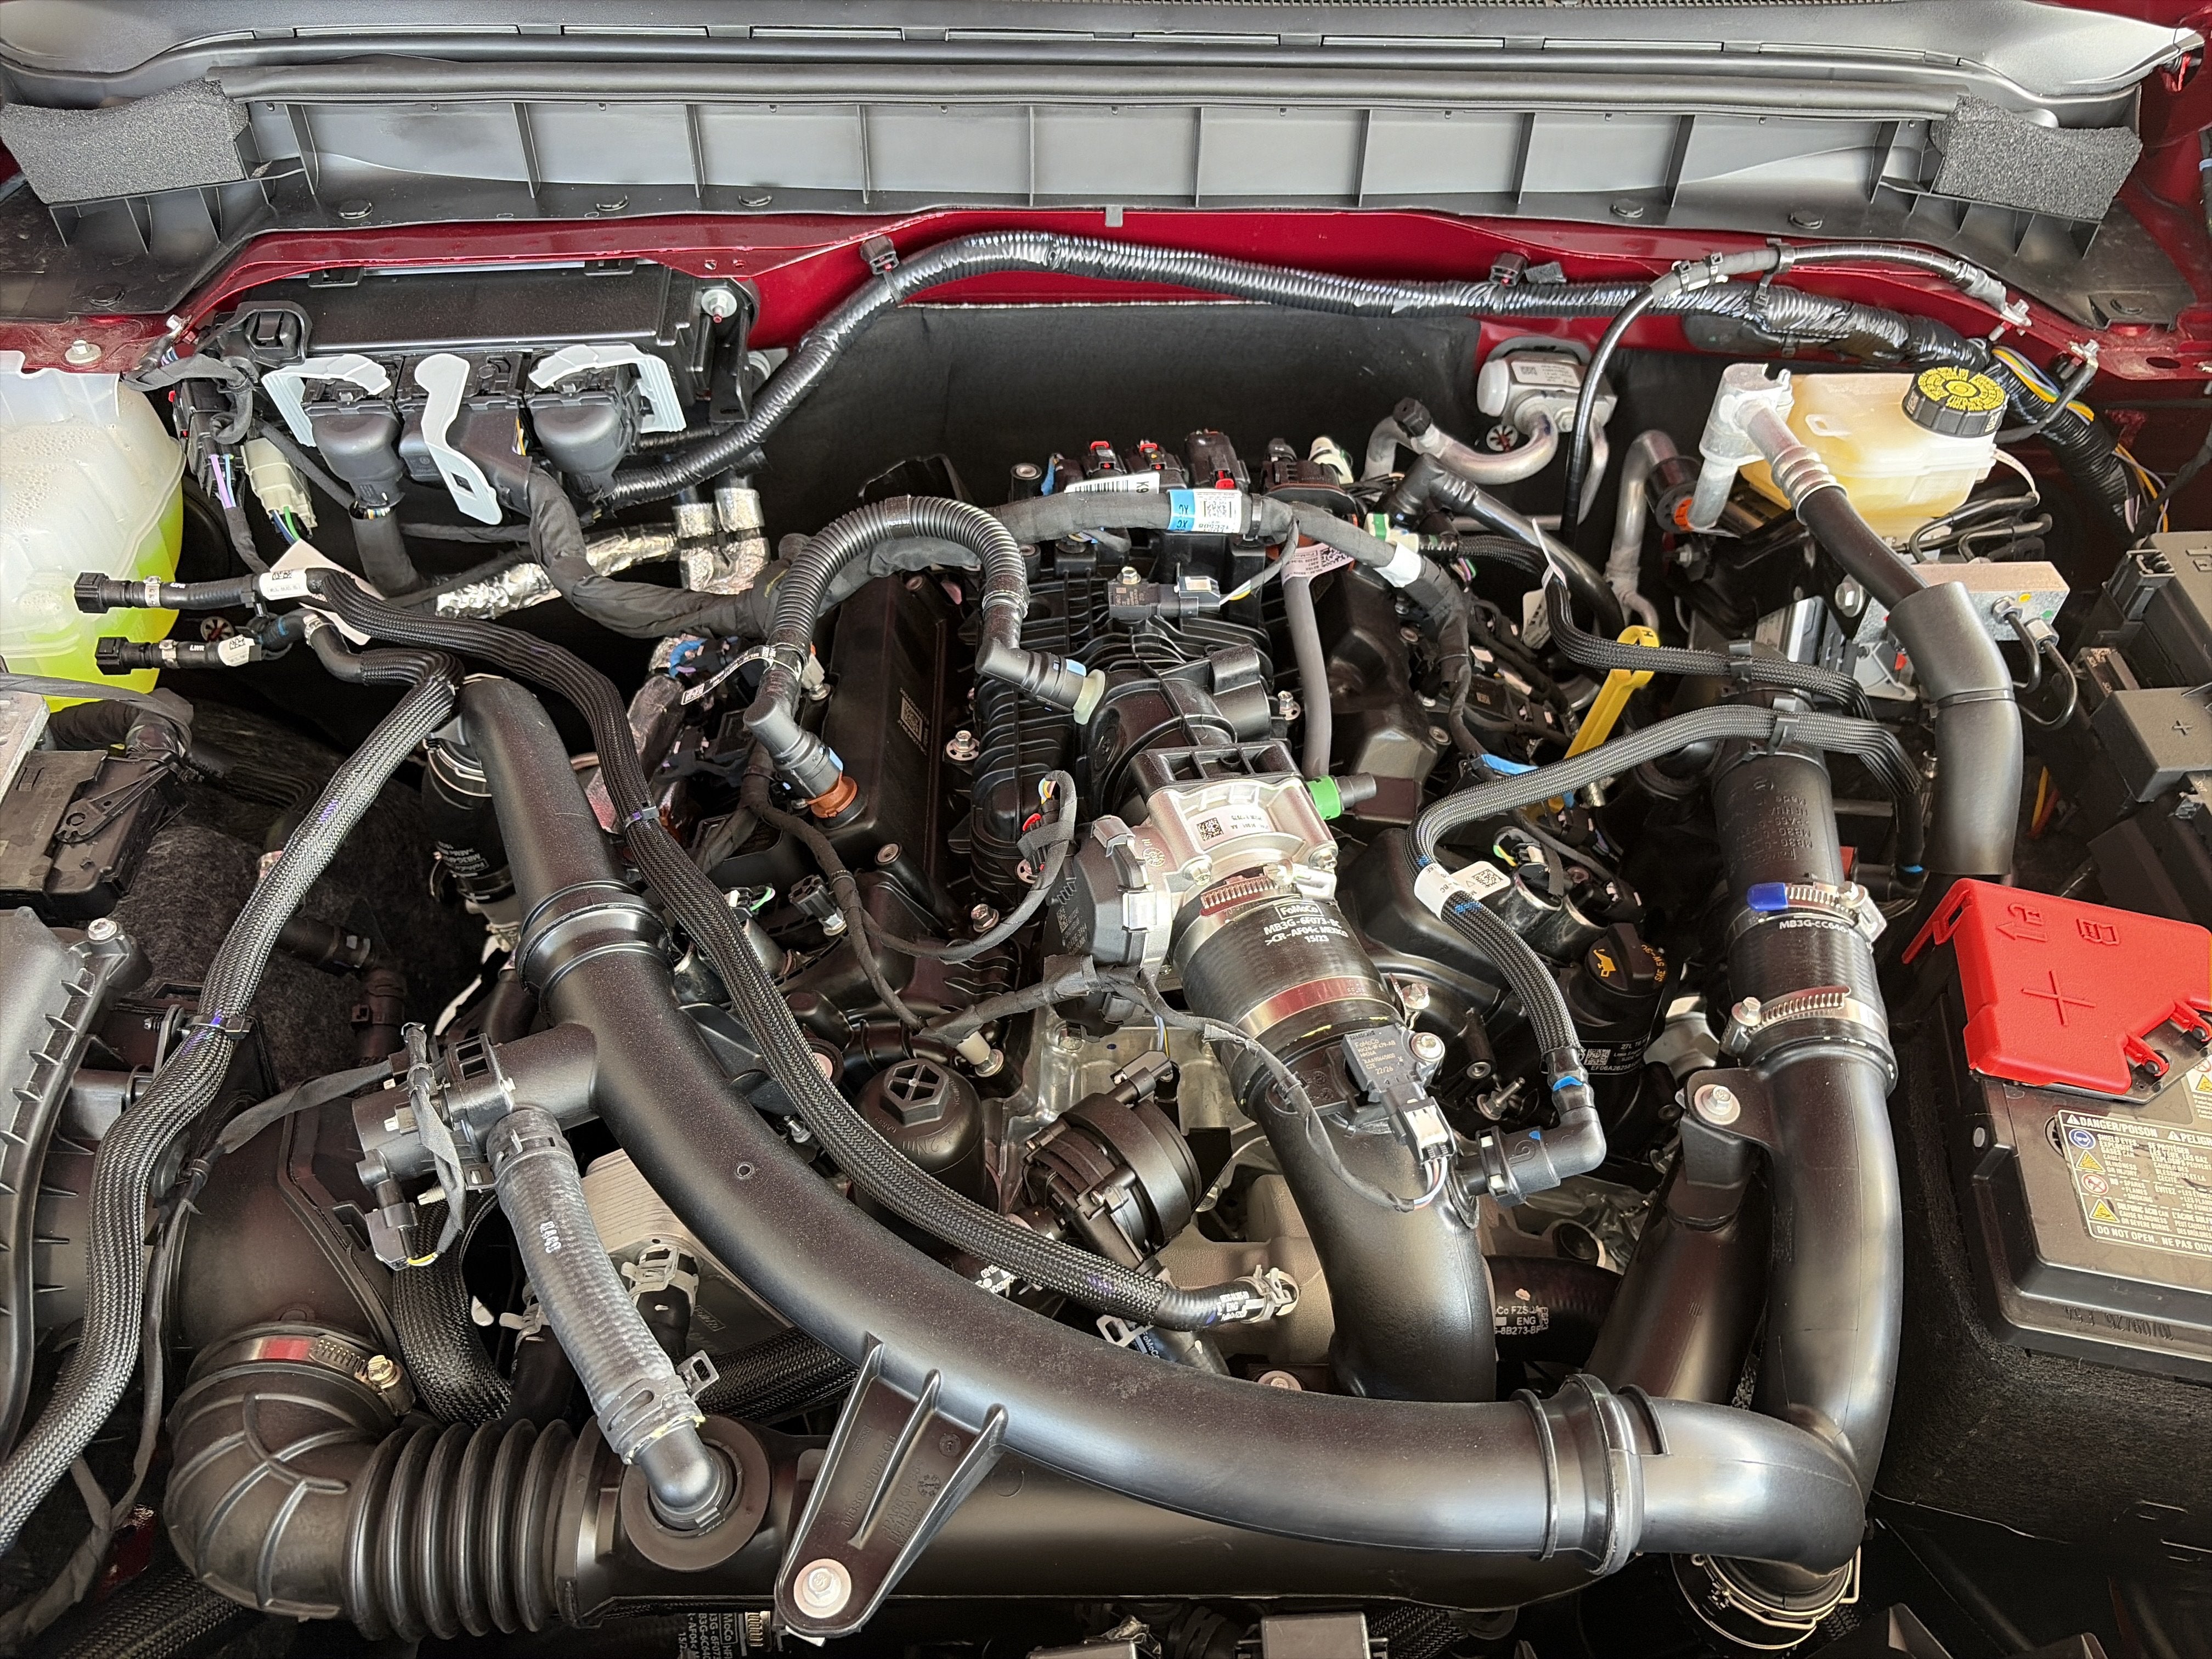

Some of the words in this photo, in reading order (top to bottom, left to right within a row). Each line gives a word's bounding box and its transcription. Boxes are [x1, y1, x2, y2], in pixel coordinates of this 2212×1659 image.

[1280, 905, 1318, 916] FoMoCo
[1319, 926, 1349, 938] MEXICO
[1654, 969, 1666, 983] SAE
[1355, 1039, 1379, 1048] FoMoCo
[2079, 1116, 2158, 1138] DANGER/POISON
[2097, 1133, 2119, 1144] SHIELD
[2120, 1138, 2140, 1147] EYES.
[2099, 1141, 2134, 1152] EXPLOSIVE
[2104, 1160, 2137, 1171] BLINDNESS
[2124, 1180, 2146, 1189] SPARKS
[2125, 1187, 2148, 1196] FLAMES
[2127, 1193, 2153, 1203] SMOKING
[2137, 1213, 2168, 1224] BLINDNESS
[2097, 1225, 2110, 1235] DO
[2111, 1228, 2129, 1239] NOT
[2131, 1232, 2158, 1244] OPEN.
[2162, 1237, 2174, 1246] NE
[2175, 1239, 2193, 1250] PAS
[1516, 1317, 1537, 1325] ENG
